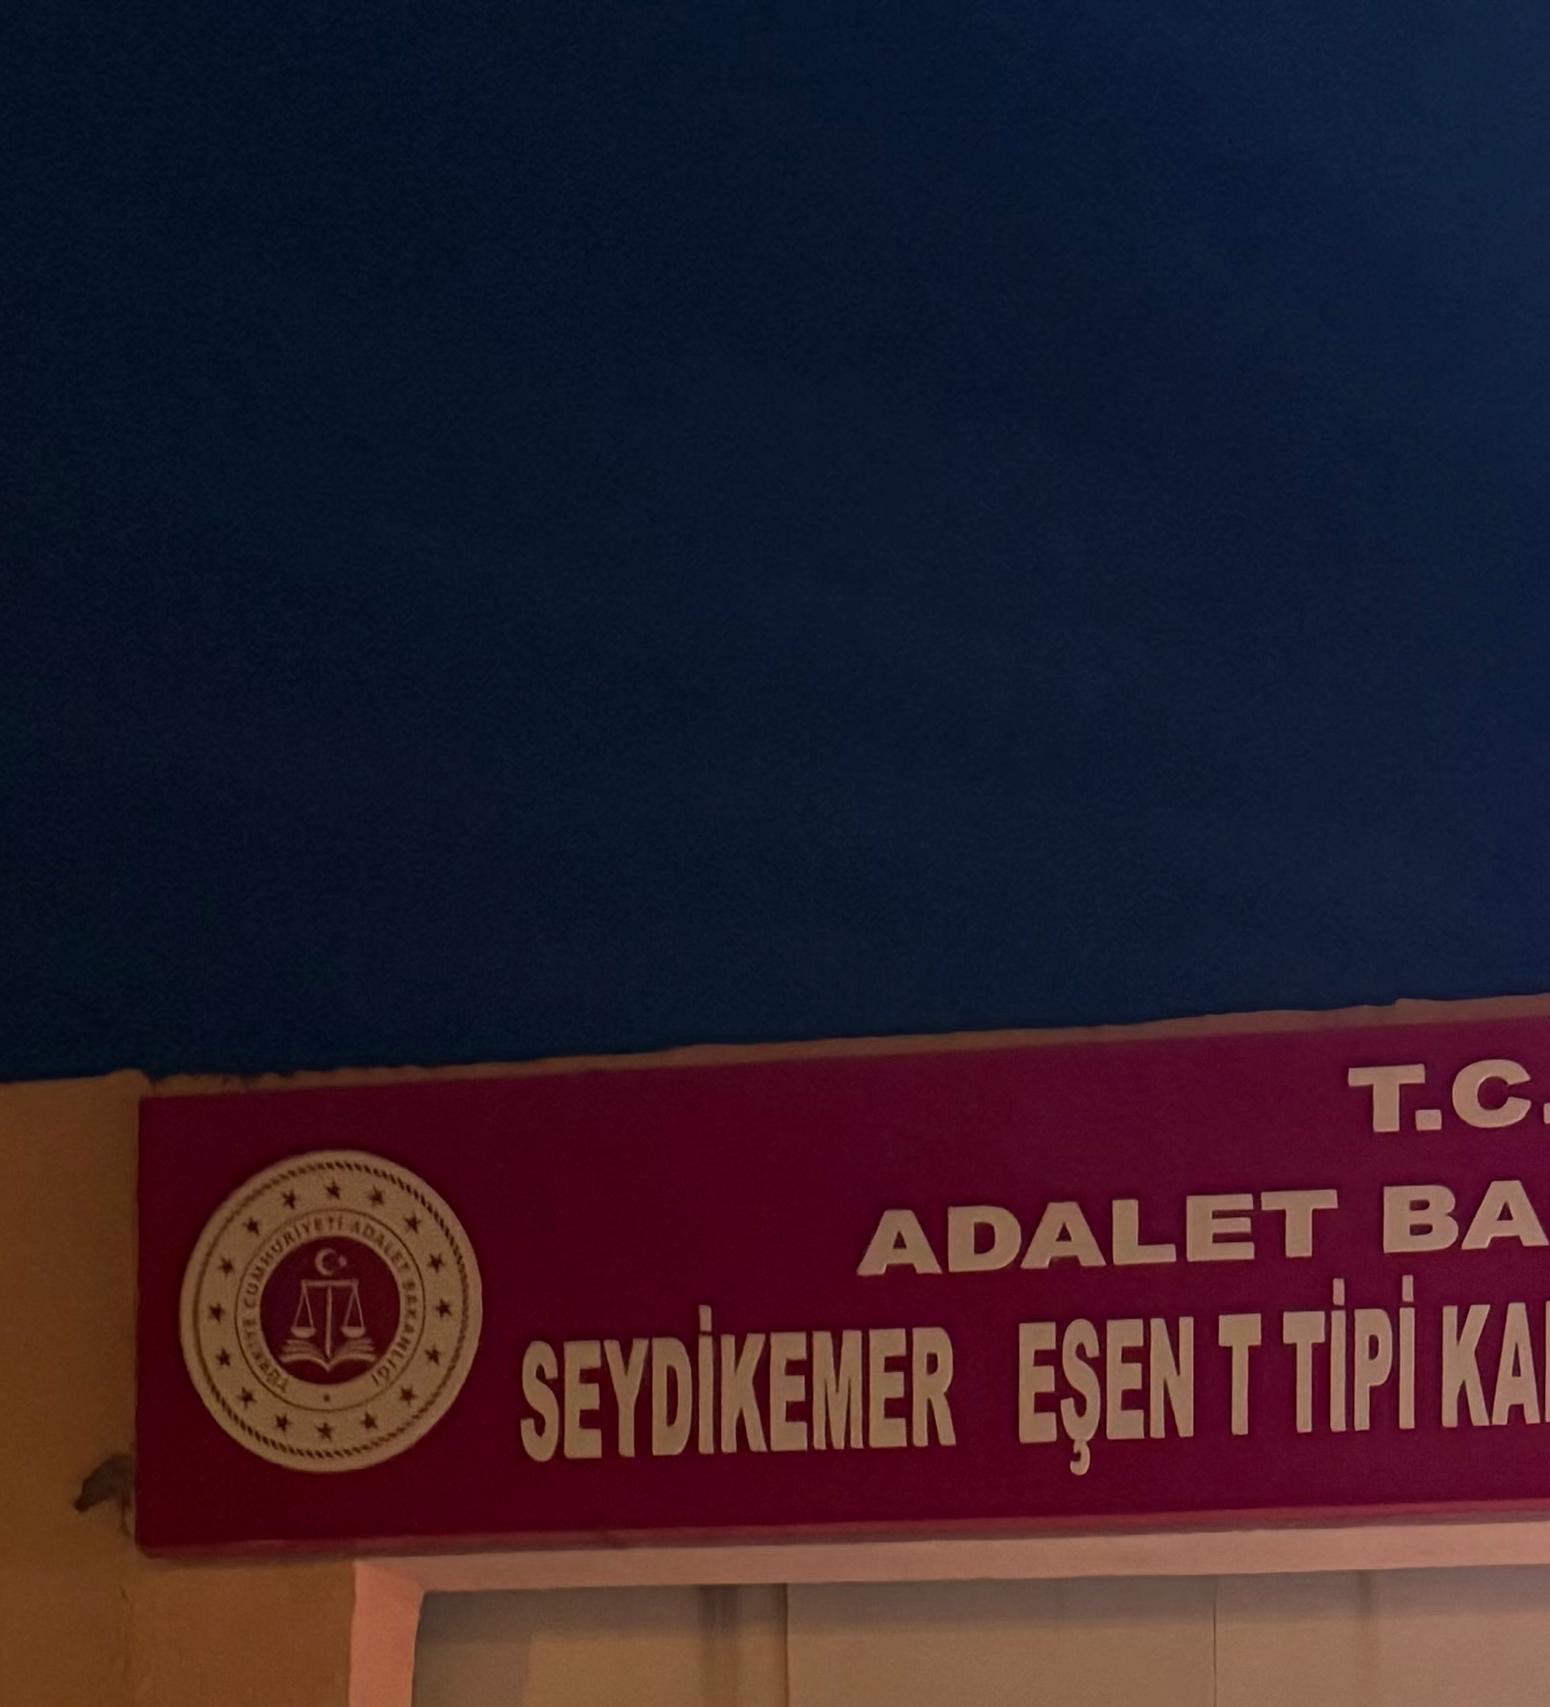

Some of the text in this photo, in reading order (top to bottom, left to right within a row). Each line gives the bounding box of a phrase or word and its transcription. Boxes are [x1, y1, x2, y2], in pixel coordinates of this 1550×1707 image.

[857, 1190, 1338, 1275] ADALET
[521, 1304, 957, 1463] SEYDİKEMER
[1018, 1316, 1195, 1475] EŞEN
[1217, 1313, 1262, 1436] T
[1283, 1275, 1416, 1433] TİPİ
